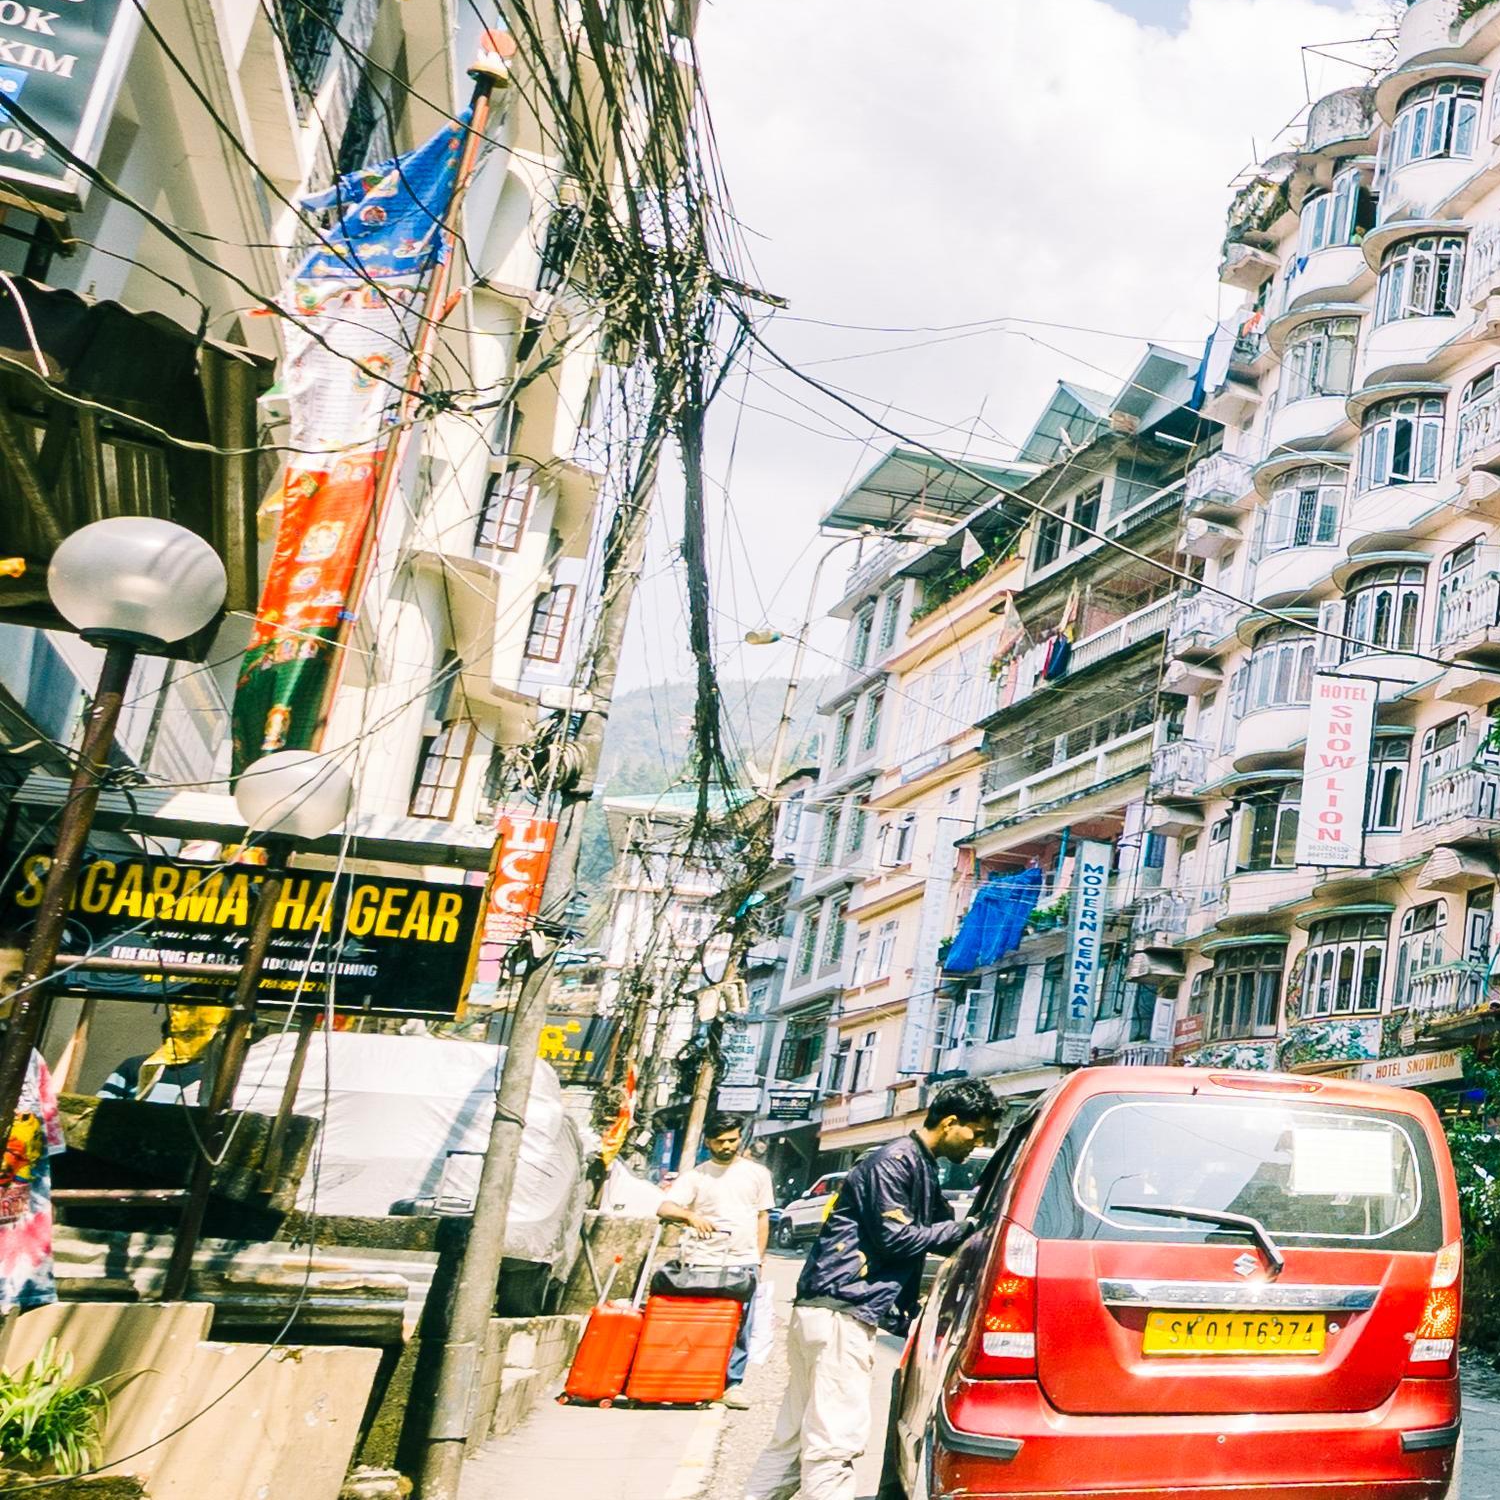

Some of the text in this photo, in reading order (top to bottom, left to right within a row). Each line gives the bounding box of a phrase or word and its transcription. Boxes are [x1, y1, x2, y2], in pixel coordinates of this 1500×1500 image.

[1320, 684, 1367, 701] HOTEL
[1319, 705, 1356, 769] SNOW
[1317, 778, 1344, 842] LION
[16, 853, 335, 933] SGARMAHA
[347, 884, 463, 943] GEAR
[1078, 863, 1105, 933] MODERN
[1071, 936, 1094, 1019] CENTRAL
[1375, 1052, 1457, 1080] HOTEL SNOWLION
